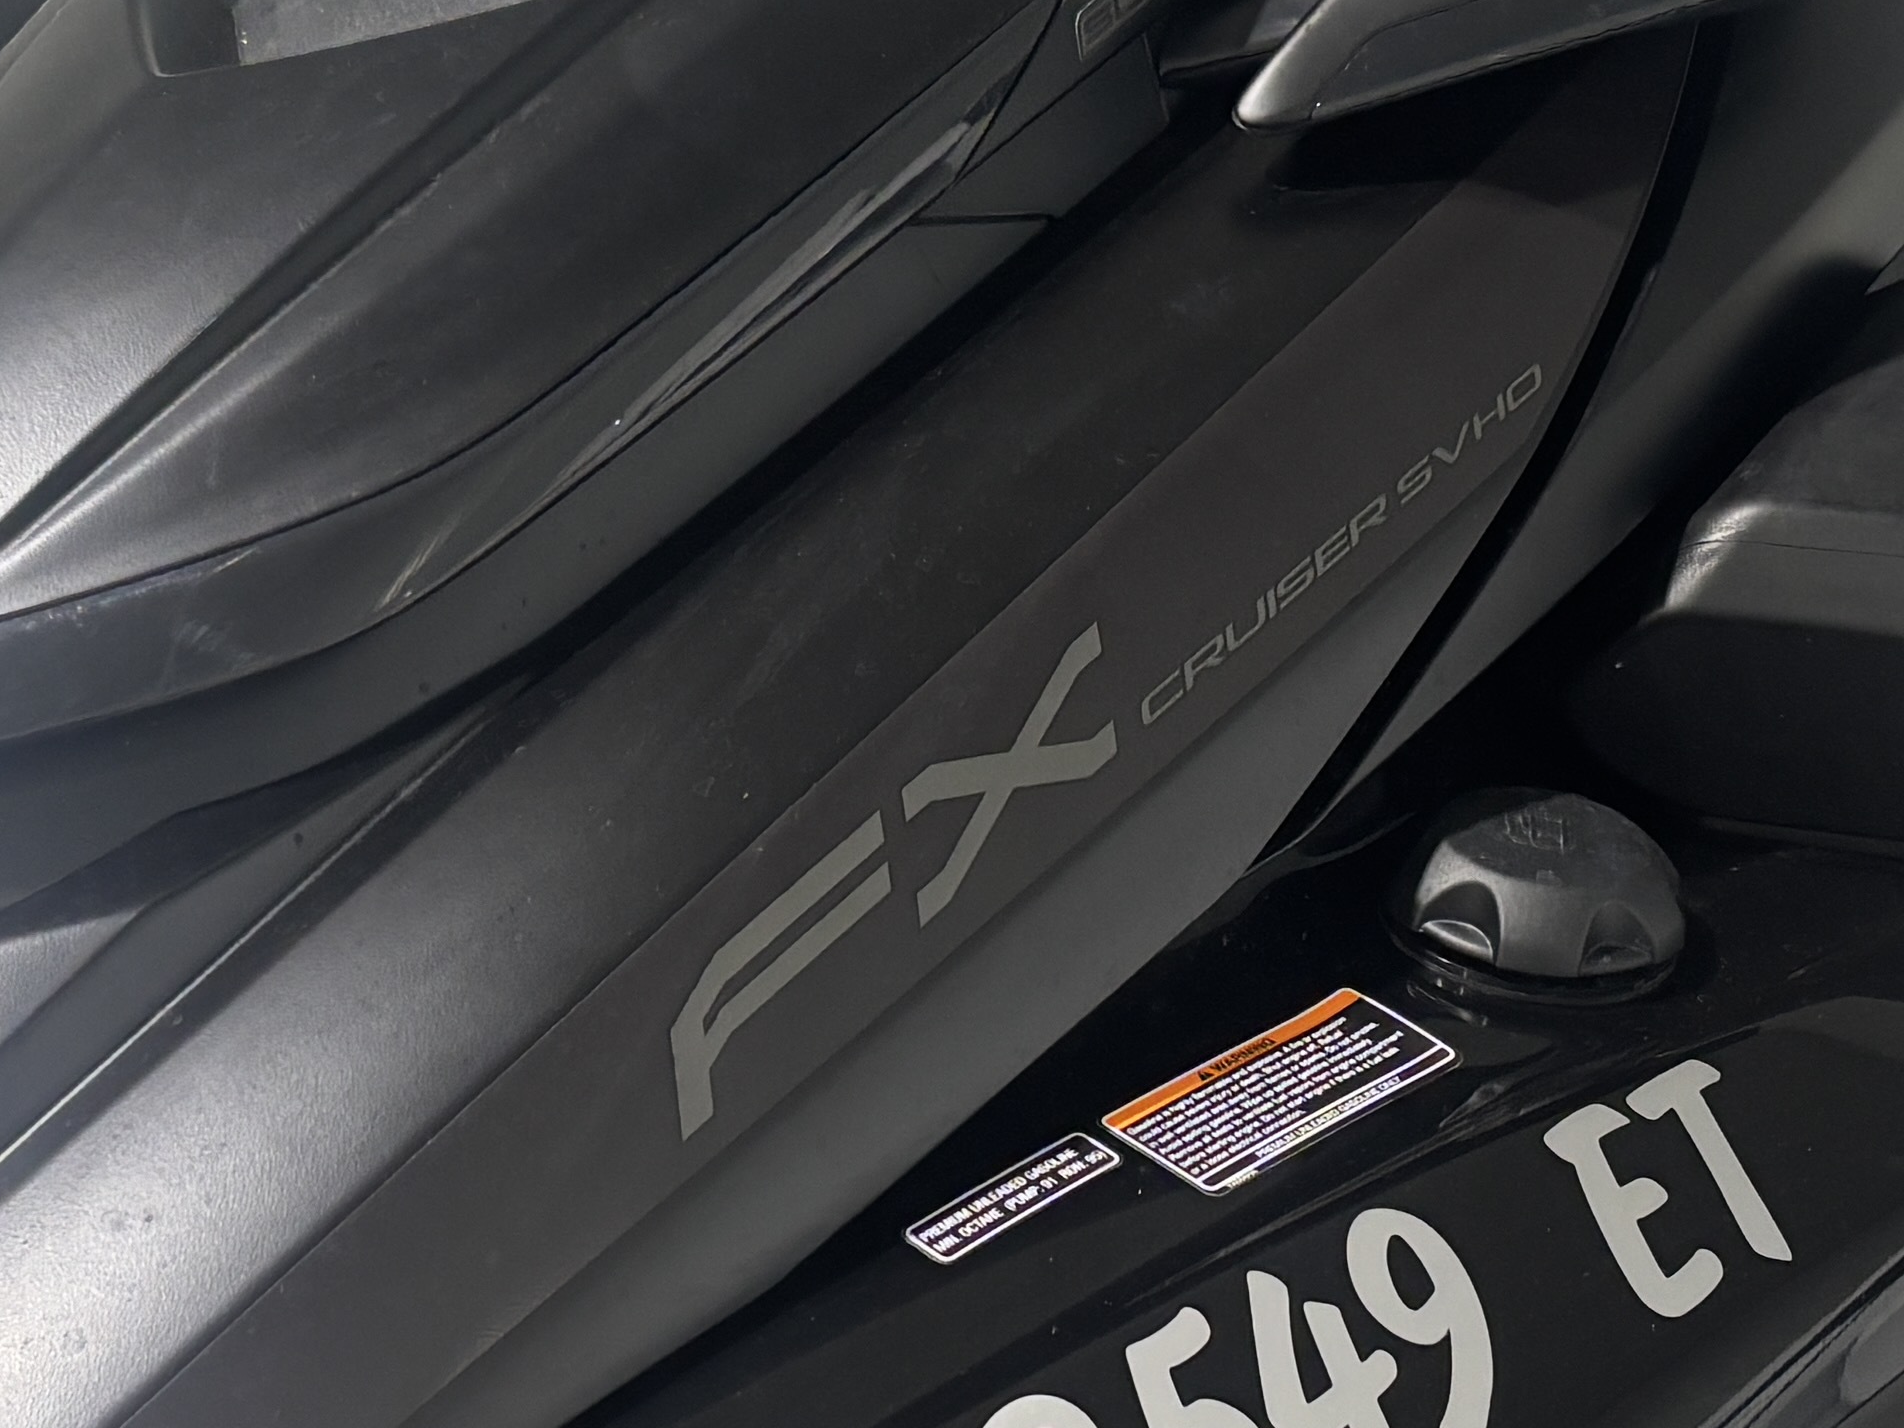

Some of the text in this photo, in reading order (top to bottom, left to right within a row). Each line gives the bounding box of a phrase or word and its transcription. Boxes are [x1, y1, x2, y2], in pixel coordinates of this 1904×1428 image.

[1141, 363, 1542, 725] CRUISER SVHO
[670, 622, 1117, 1141] FX
[919, 1149, 1079, 1242] PREMIUM UNLEADED GASOLINE
[958, 1208, 1004, 1237] OCTANE
[1543, 1059, 1792, 1318] ET
